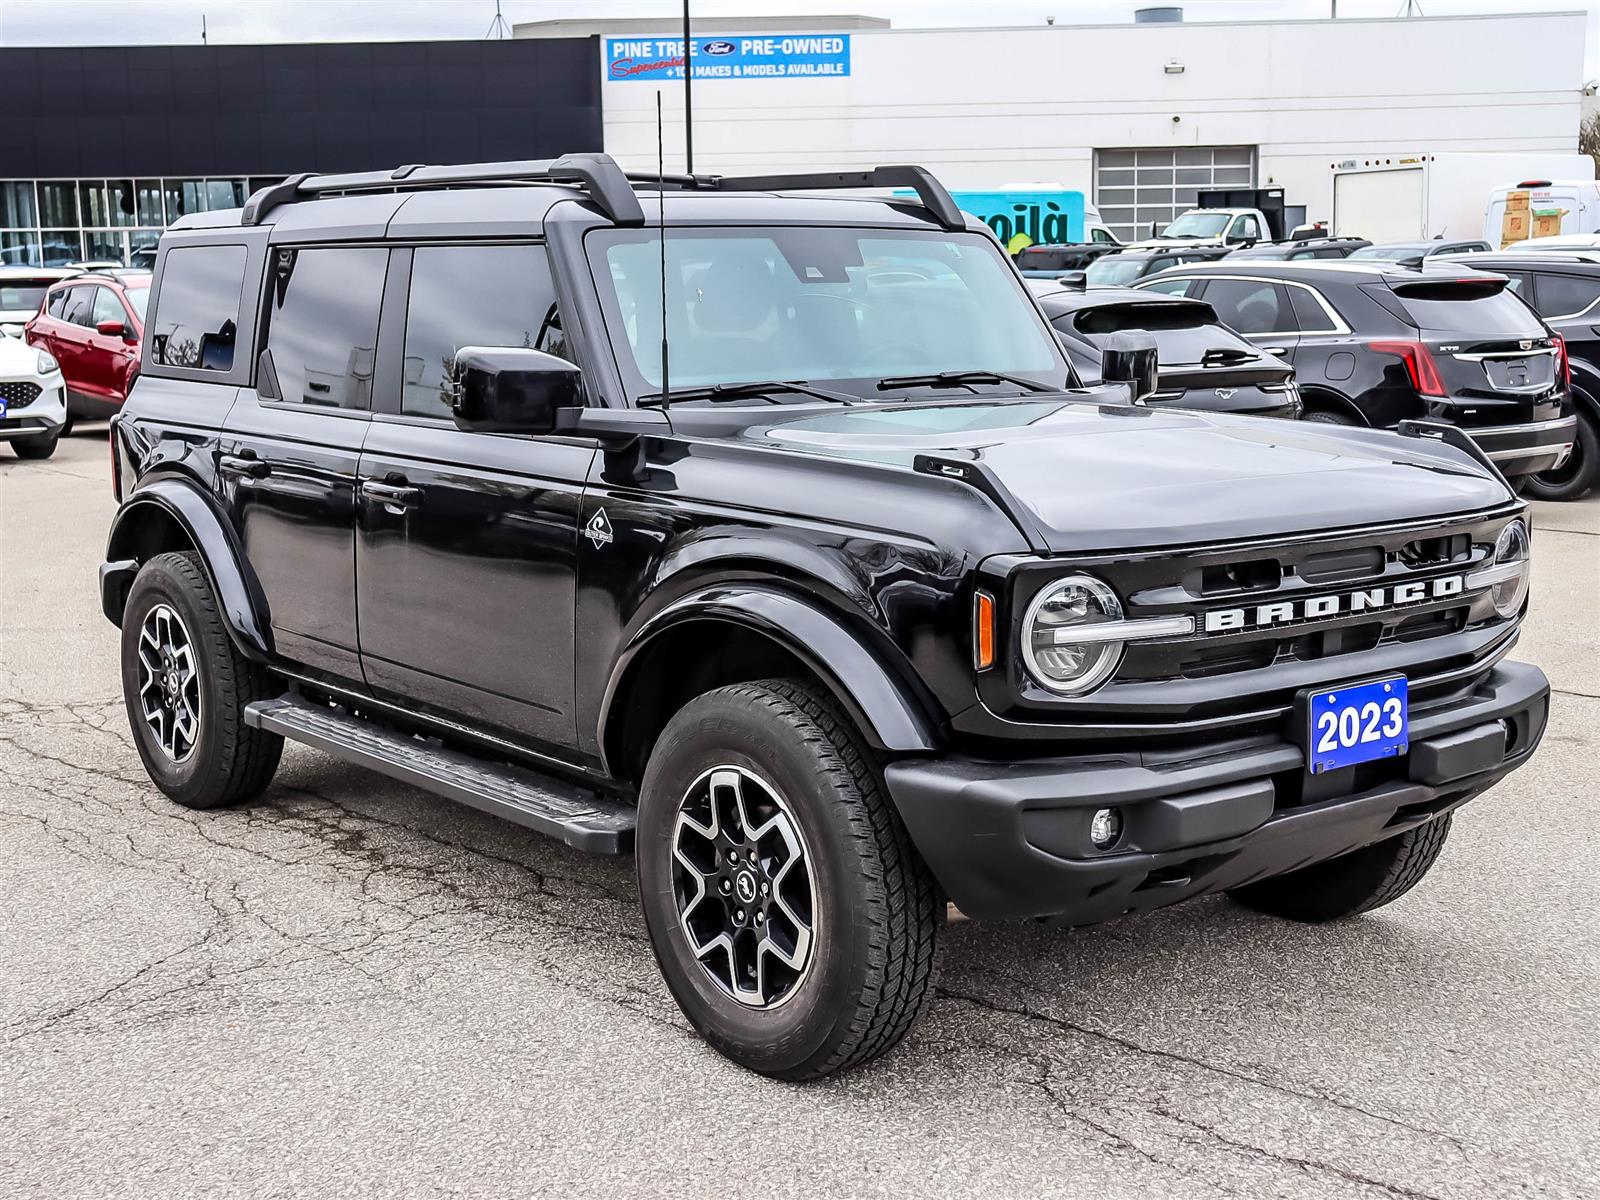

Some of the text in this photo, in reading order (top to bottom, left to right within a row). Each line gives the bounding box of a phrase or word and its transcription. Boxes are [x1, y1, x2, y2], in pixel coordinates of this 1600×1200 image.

[613, 41, 698, 57] PINE TREE
[708, 42, 731, 54] Ford
[741, 38, 844, 55] PRE-OWNED
[695, 66, 732, 77] MAKES
[733, 65, 742, 76] &
[743, 64, 785, 76] MODELS
[787, 63, 844, 75] AVAILABLE
[1205, 575, 1464, 633] BRONCO
[1317, 697, 1403, 753] 2023
